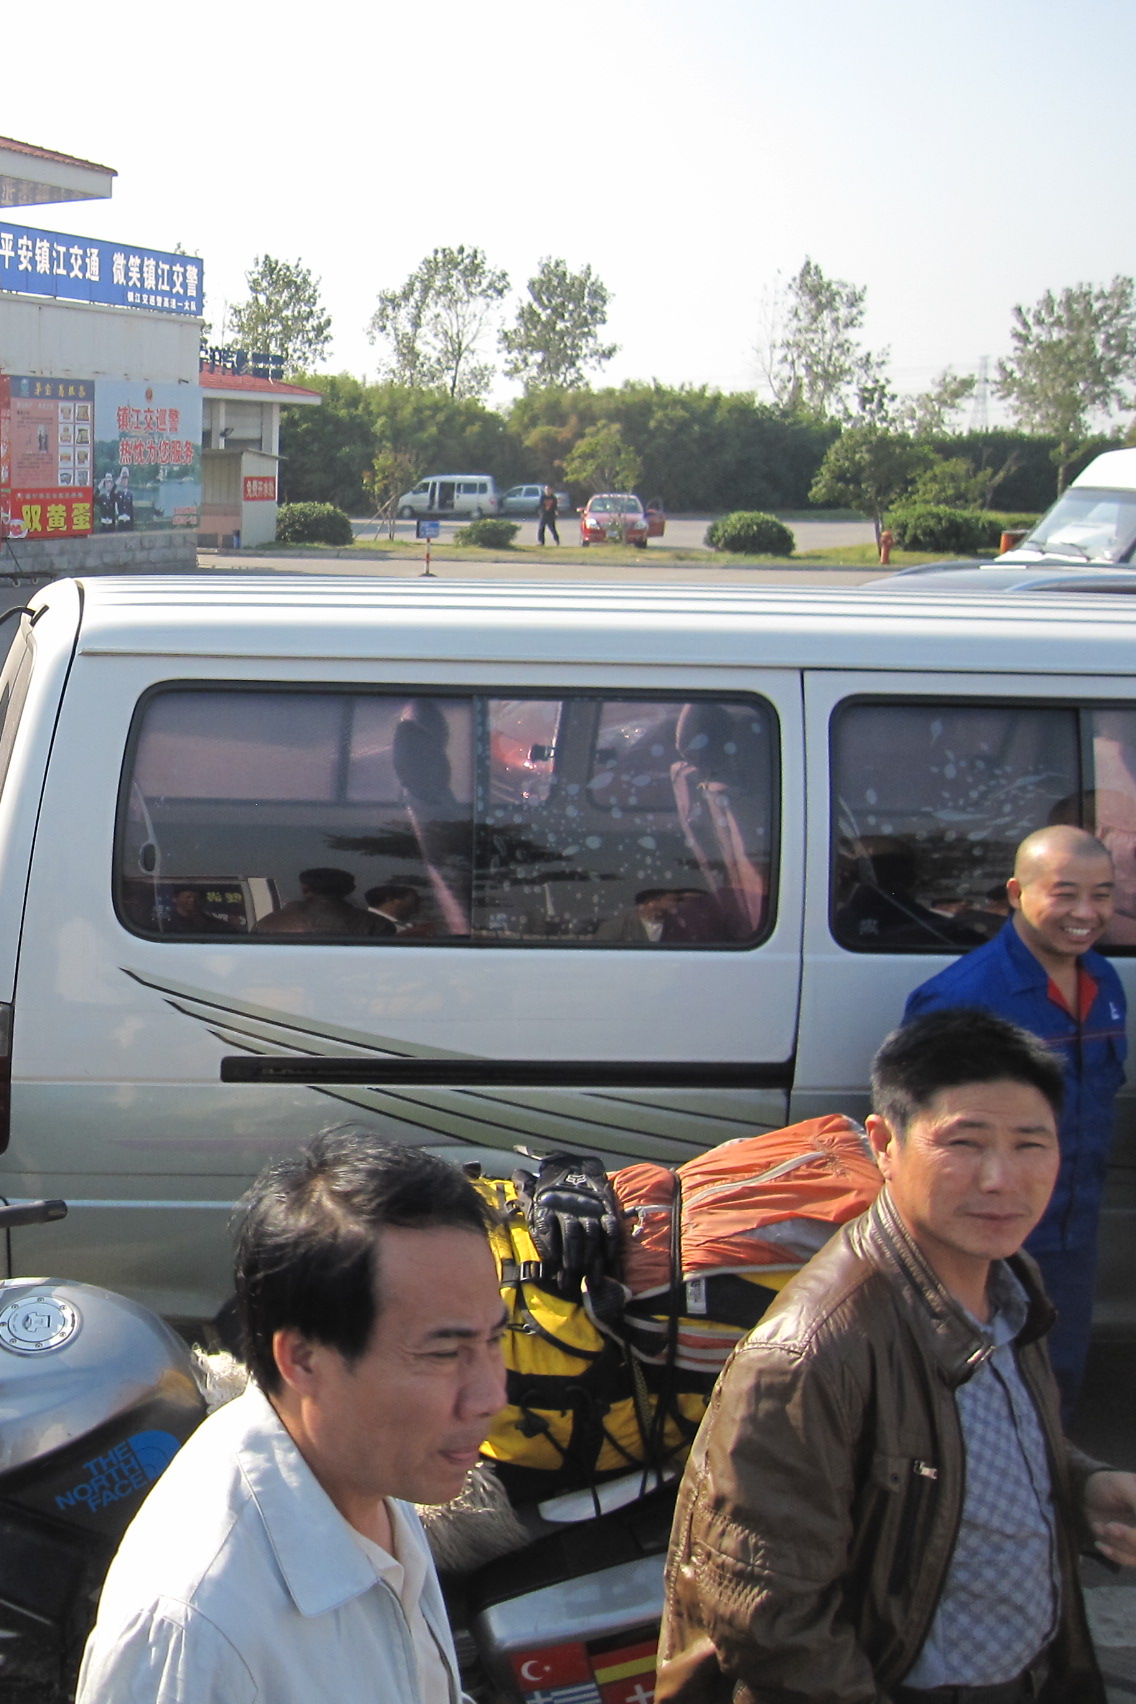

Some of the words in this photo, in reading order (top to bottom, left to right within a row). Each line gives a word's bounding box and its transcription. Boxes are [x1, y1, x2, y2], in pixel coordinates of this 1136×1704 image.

[0, 232, 99, 282] 平安镇江交通
[112, 252, 198, 297] 微笑镇江交警
[117, 405, 180, 432] 镇江交巡警
[119, 437, 194, 465] 热忱为您服务
[20, 503, 91, 532] 双黄蛋
[82, 1440, 129, 1477] THE
[54, 1453, 141, 1511] NORTH
[87, 1470, 149, 1513] FACE
